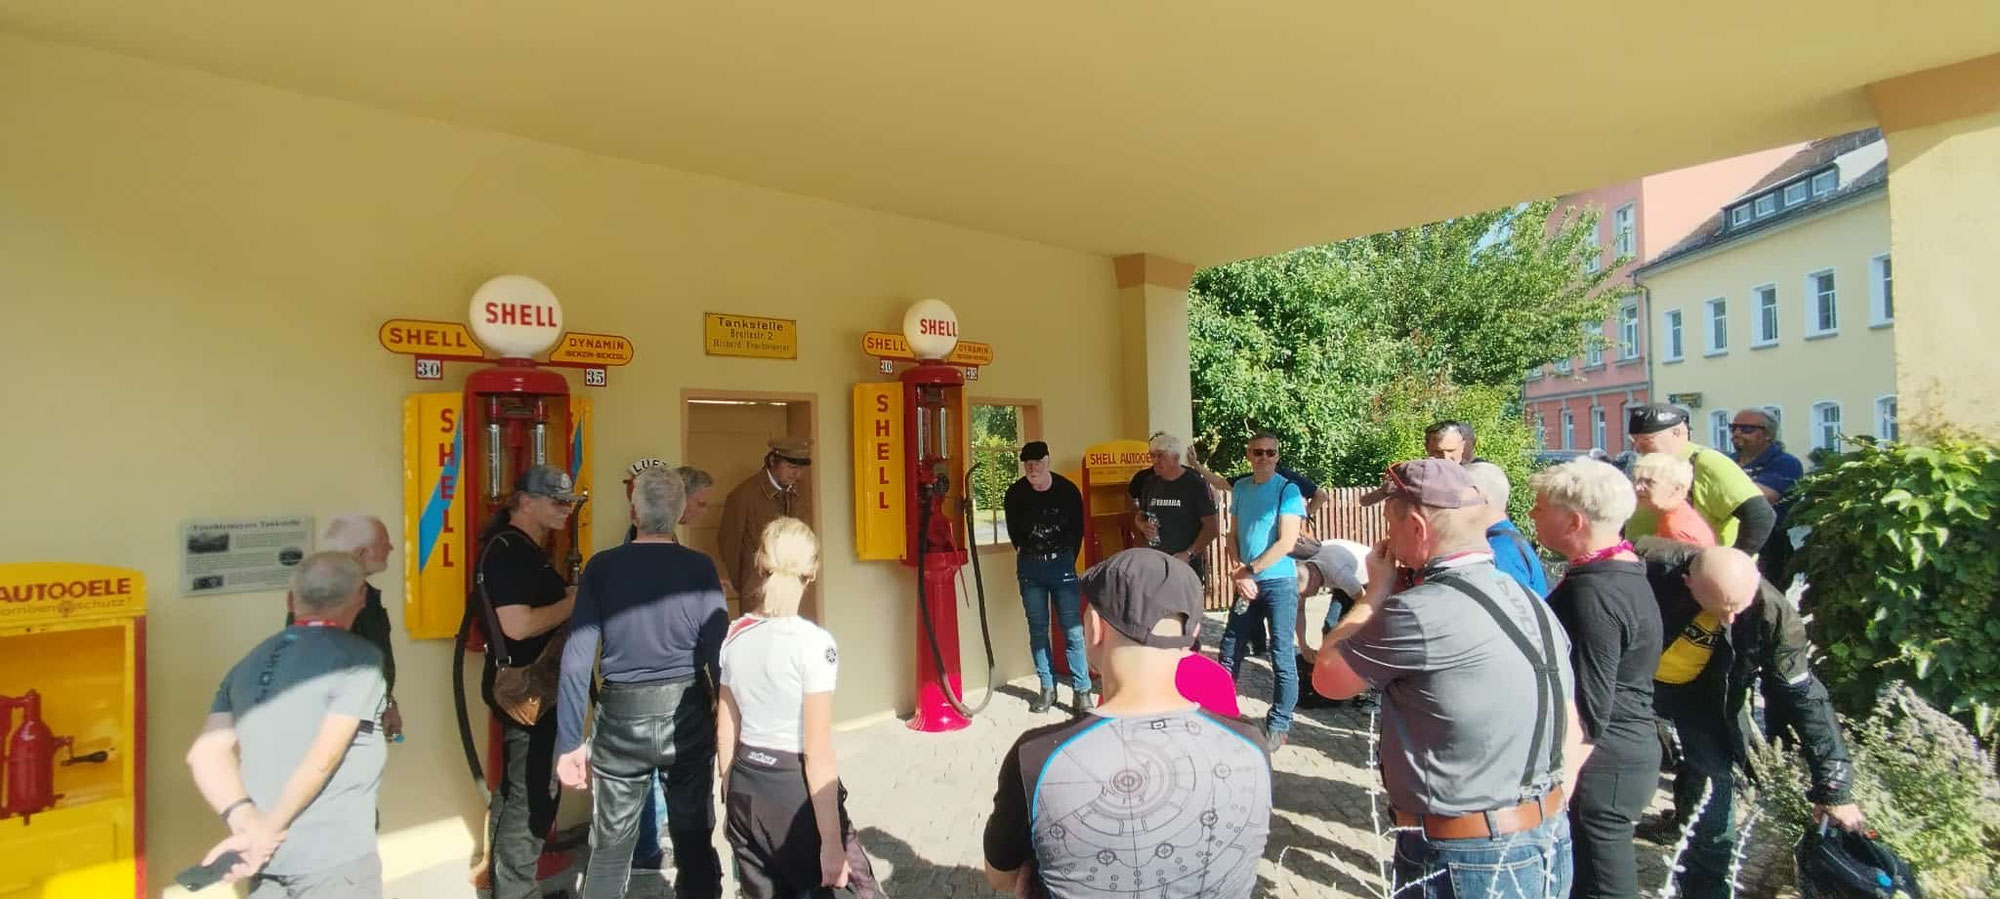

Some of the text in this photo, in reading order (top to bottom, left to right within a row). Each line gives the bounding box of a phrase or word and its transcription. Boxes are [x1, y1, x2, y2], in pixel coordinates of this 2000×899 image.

[485, 301, 557, 327] SHELL
[718, 316, 783, 331] Tankstelle
[920, 318, 957, 337] SHELL
[389, 327, 468, 349] SHELL
[569, 337, 625, 350] DYNAMIN
[767, 332, 774, 340] 2
[866, 337, 907, 352] SHELL
[416, 361, 441, 377] 30
[587, 370, 604, 384] 35
[875, 394, 890, 509] SHELL
[1090, 453, 1117, 465] SHELL
[632, 459, 666, 472] LUF
[438, 408, 454, 568] SHELL
